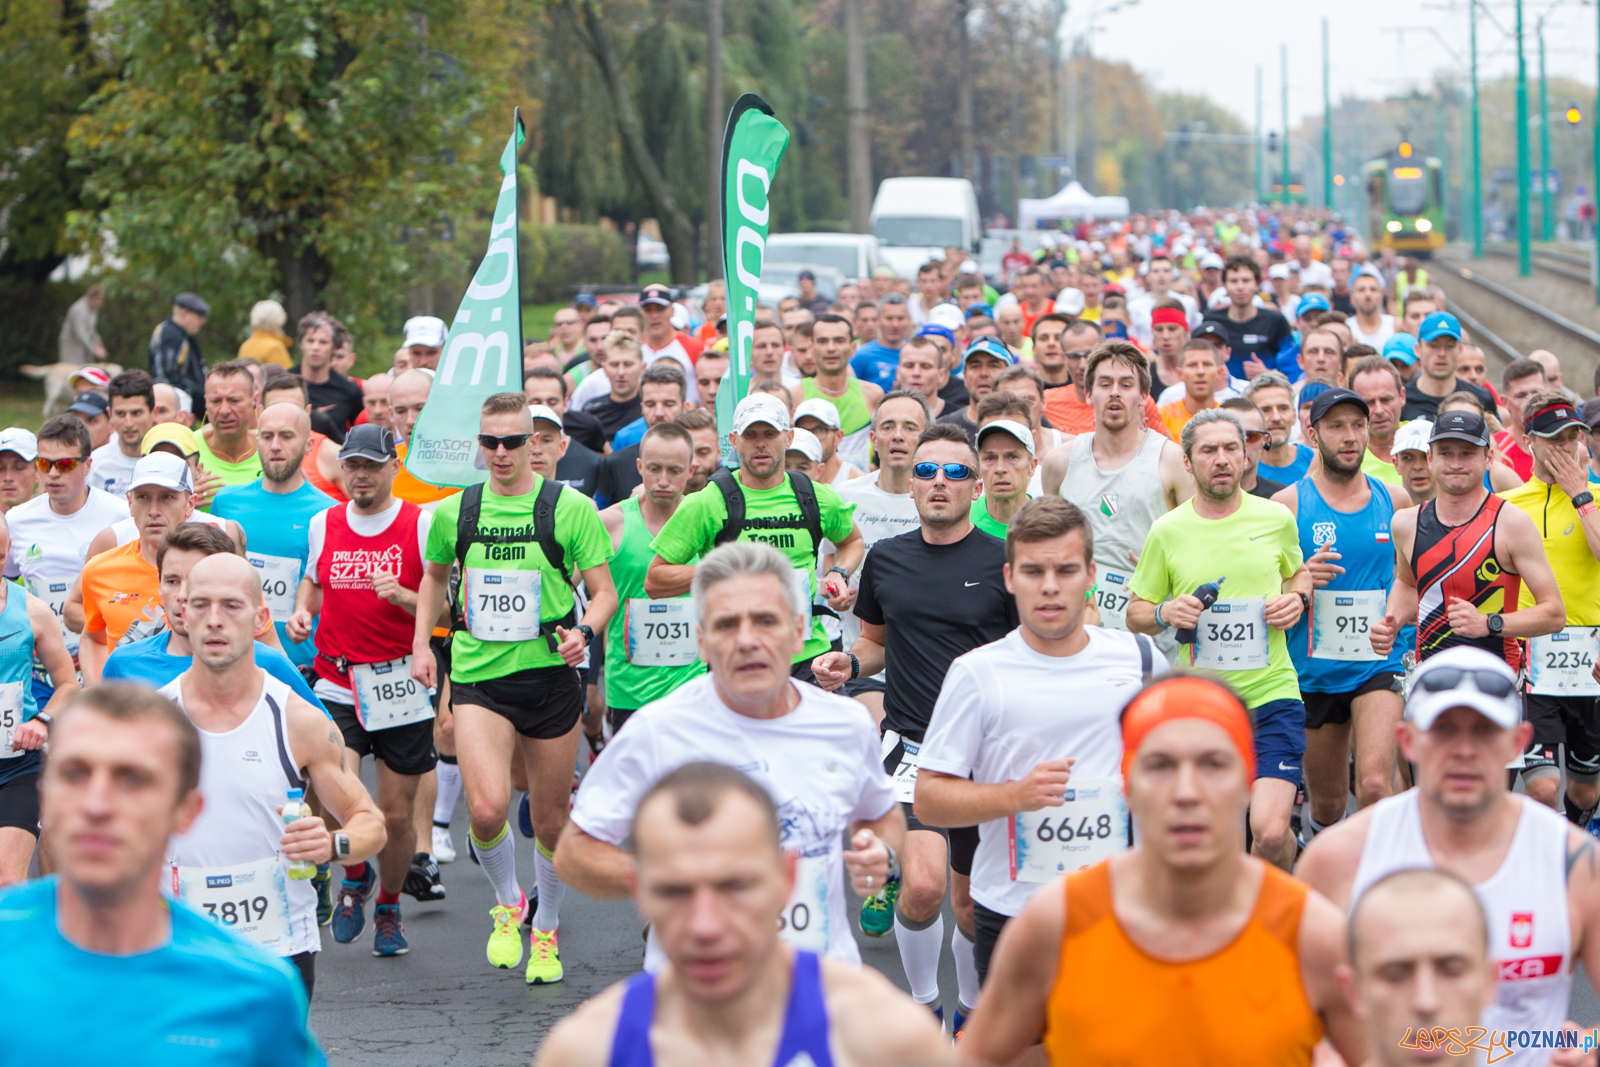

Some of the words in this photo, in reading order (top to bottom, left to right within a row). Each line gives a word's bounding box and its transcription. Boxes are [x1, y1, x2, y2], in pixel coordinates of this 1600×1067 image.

[748, 533, 795, 548] Team
[331, 548, 390, 562] DRUŻYNA
[484, 543, 526, 560] Team
[329, 561, 403, 580] SZPIKU
[478, 594, 526, 612] 7180
[644, 622, 689, 640] 7031
[1207, 622, 1254, 642] 3621
[1335, 616, 1369, 634] 913
[1546, 651, 1593, 669] 2234
[372, 678, 416, 702] 1850
[0, 709, 14, 728] 5
[1036, 813, 1111, 842] 6648
[1061, 844, 1091, 852] Marcin
[202, 895, 268, 926] 3819
